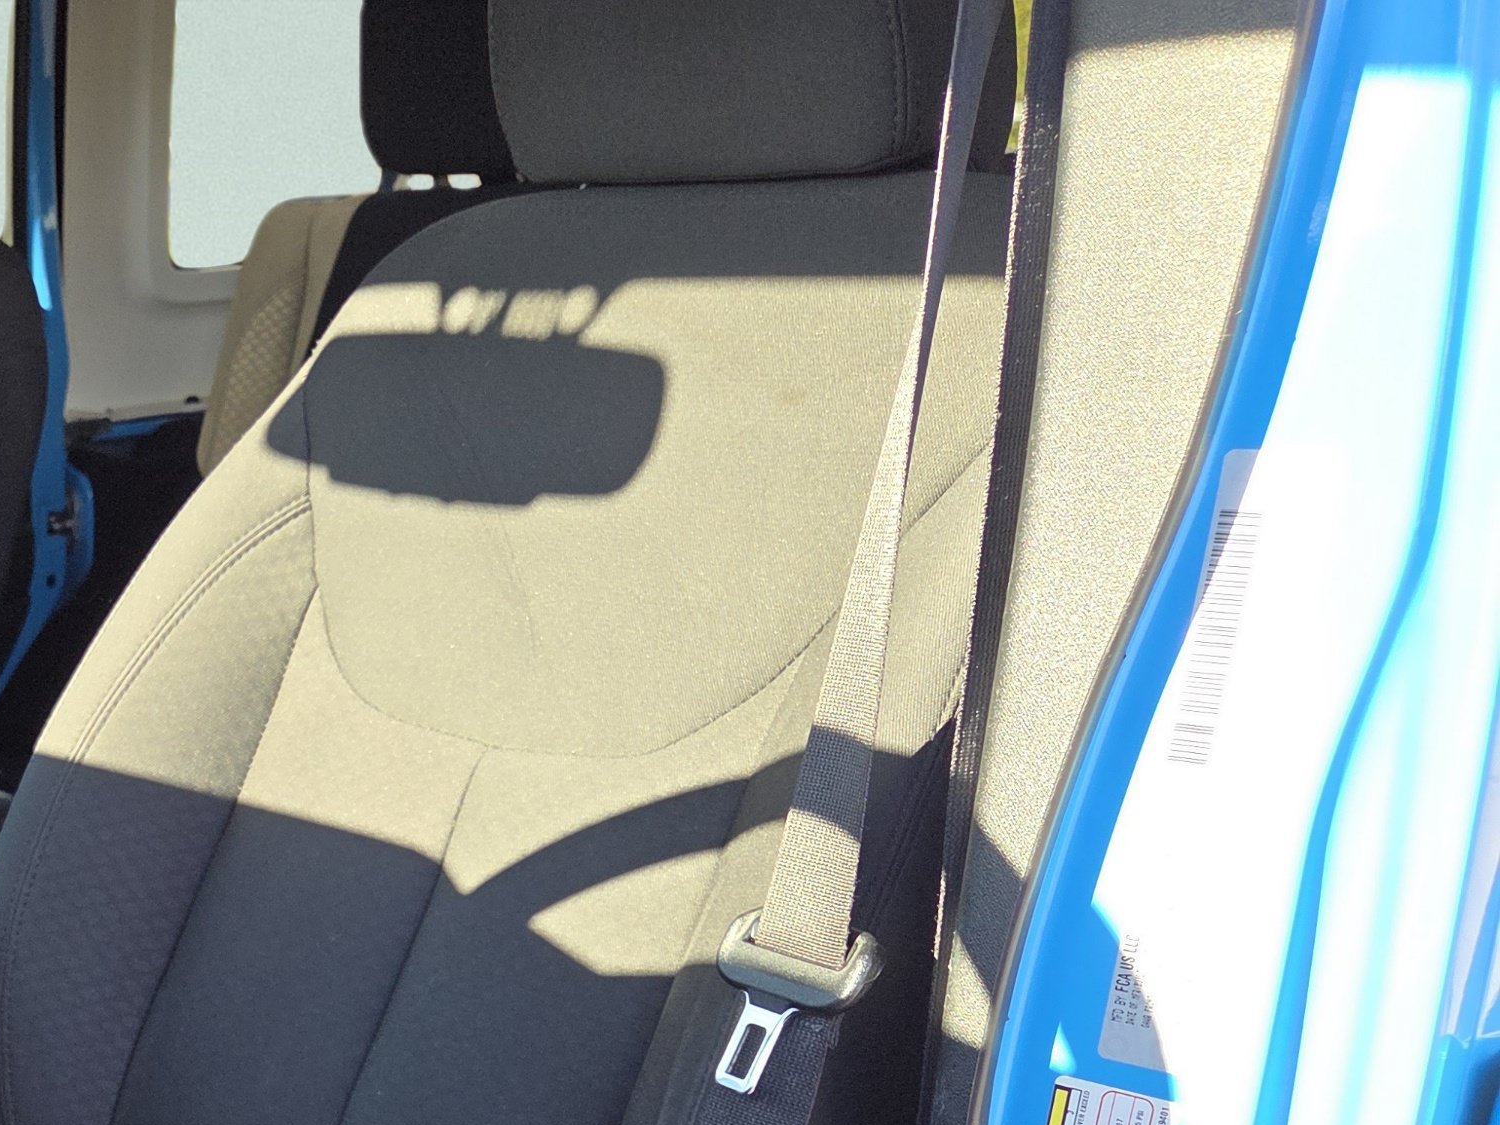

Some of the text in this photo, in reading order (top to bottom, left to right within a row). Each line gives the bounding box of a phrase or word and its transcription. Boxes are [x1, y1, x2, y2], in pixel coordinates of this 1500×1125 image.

[1123, 934, 1139, 953] LLC
[1120, 955, 1135, 970] US
[1115, 974, 1132, 993] FCA
[1114, 996, 1126, 1005] BY
[1110, 1008, 1124, 1023] MFD
[1125, 1011, 1137, 1025] DATE
[1080, 1089, 1089, 1112] EXCEED
